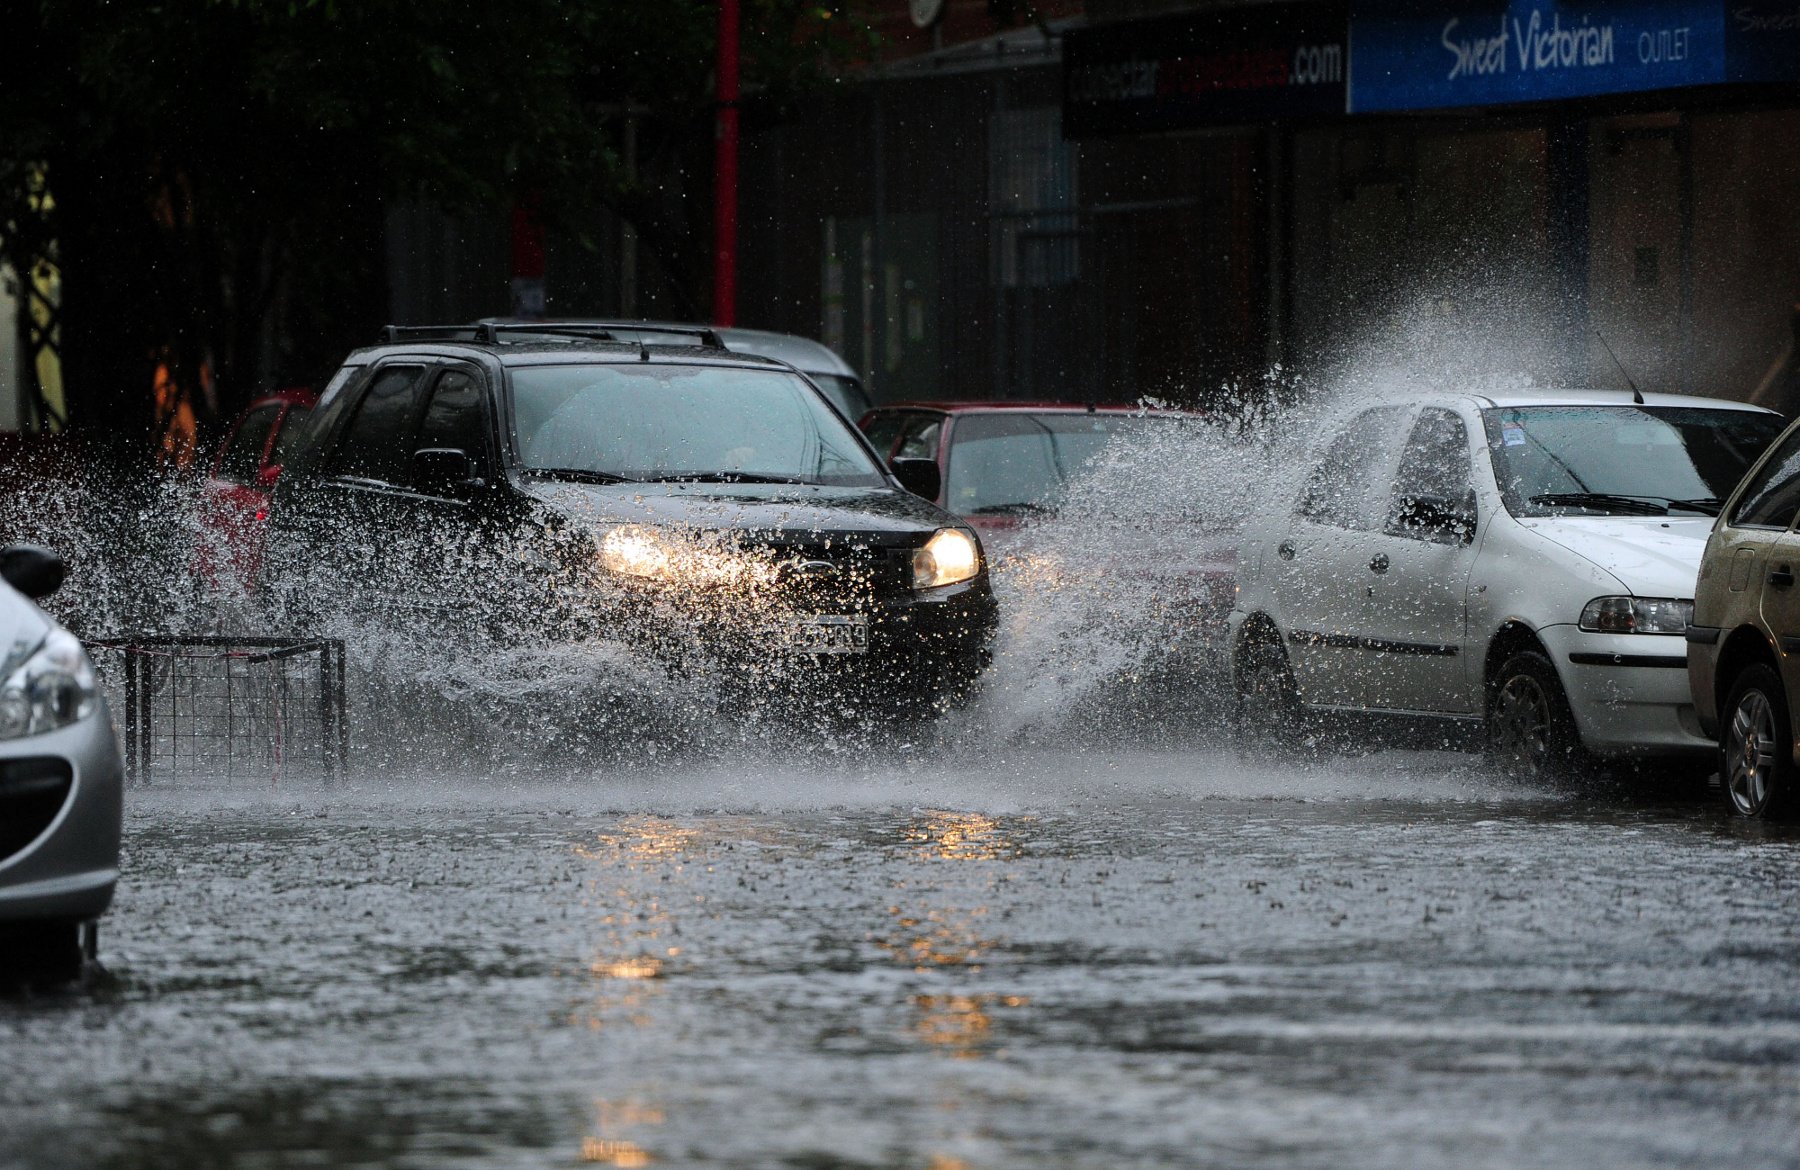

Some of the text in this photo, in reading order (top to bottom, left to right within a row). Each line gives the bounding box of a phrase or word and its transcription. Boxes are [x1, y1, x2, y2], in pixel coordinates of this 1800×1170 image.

[1441, 8, 1691, 80] Sweet Victorian OUTLET
